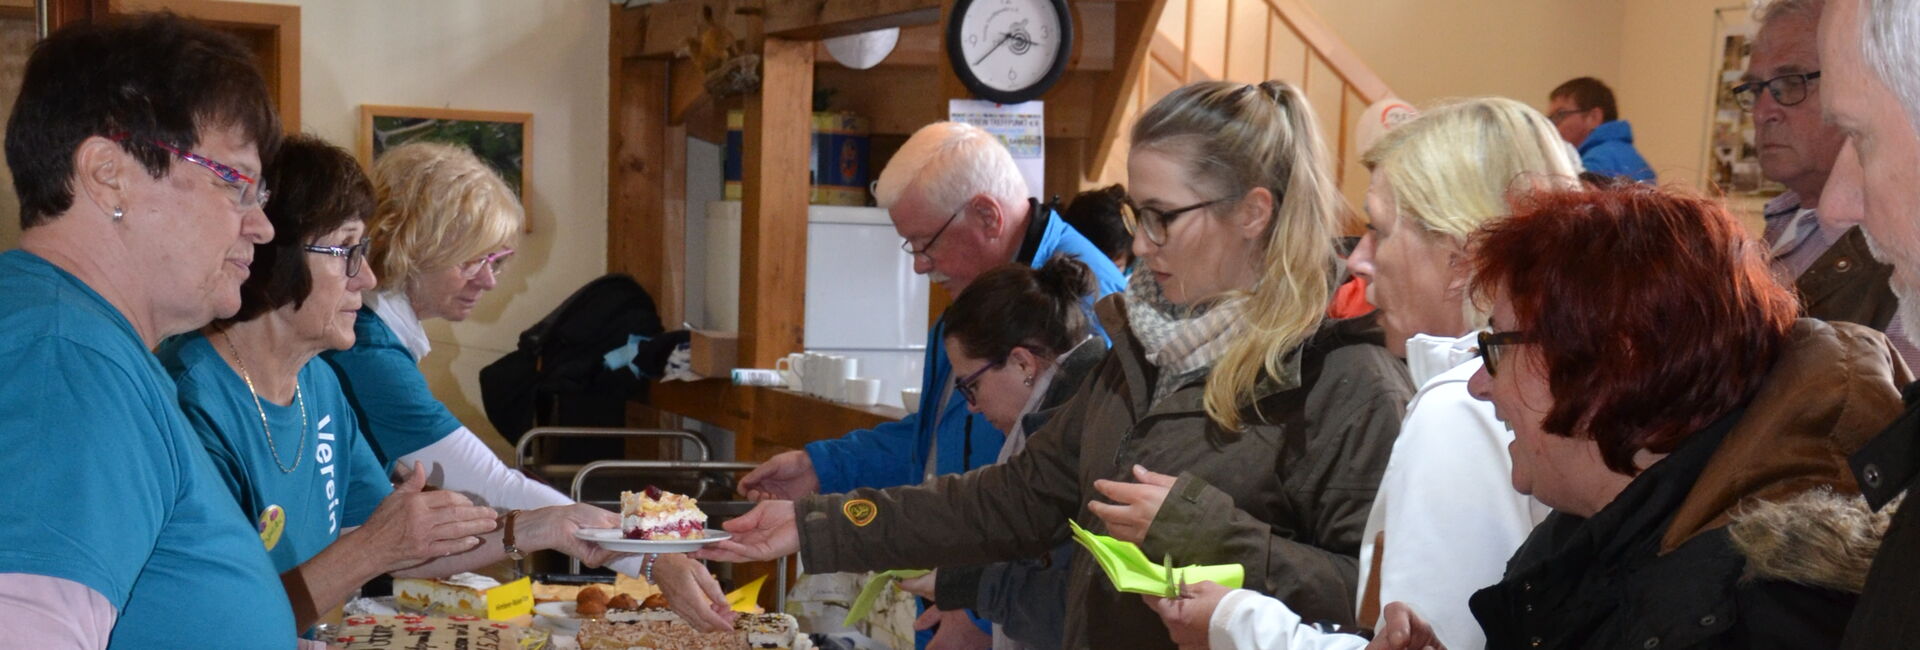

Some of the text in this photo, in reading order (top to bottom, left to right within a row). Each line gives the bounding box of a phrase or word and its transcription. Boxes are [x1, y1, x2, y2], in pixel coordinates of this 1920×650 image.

[1040, 25, 1049, 39] 3
[968, 34, 978, 48] 9
[1007, 66, 1017, 81] 6
[315, 413, 340, 535] Verein
